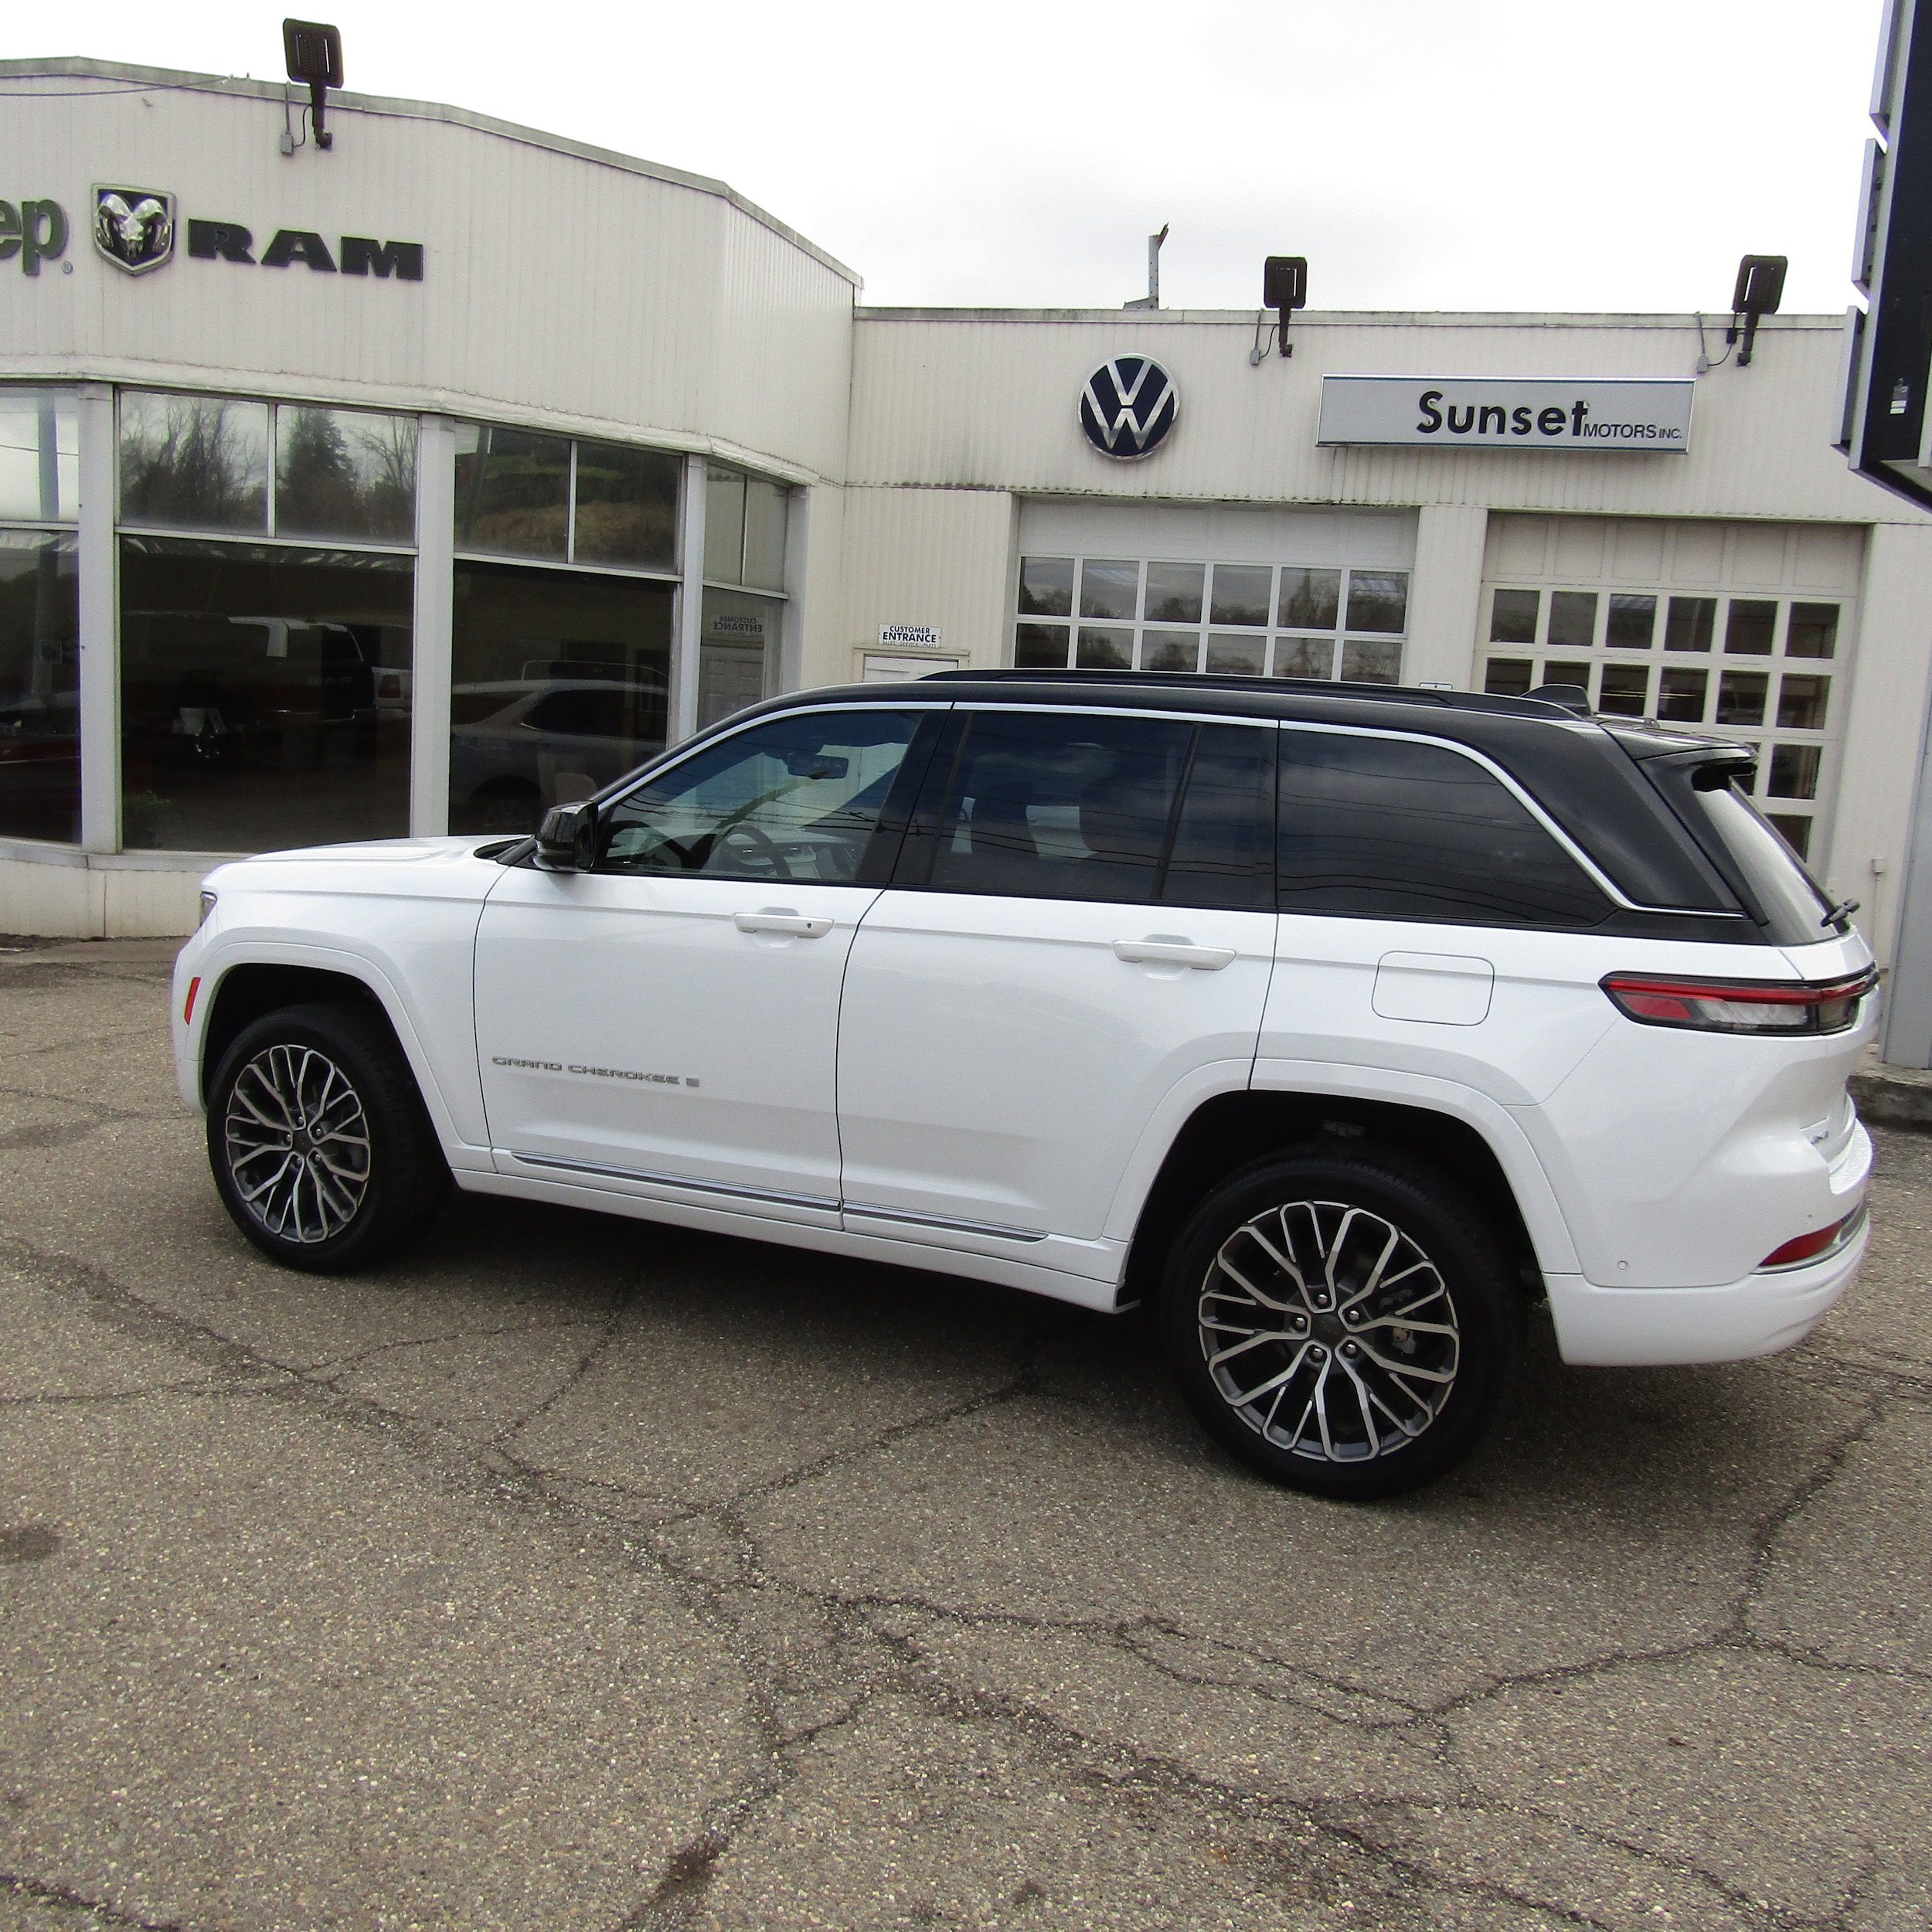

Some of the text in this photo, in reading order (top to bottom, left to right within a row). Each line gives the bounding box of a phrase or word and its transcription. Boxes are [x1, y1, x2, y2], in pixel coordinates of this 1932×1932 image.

[188, 219, 423, 281] RAM
[1416, 390, 1682, 440] Sunset MOTORS INC.
[883, 631, 937, 643] ENTRANCE
[889, 625, 930, 634] CUSTOMER
[492, 1056, 680, 1085] GRAND CHEROKEE
